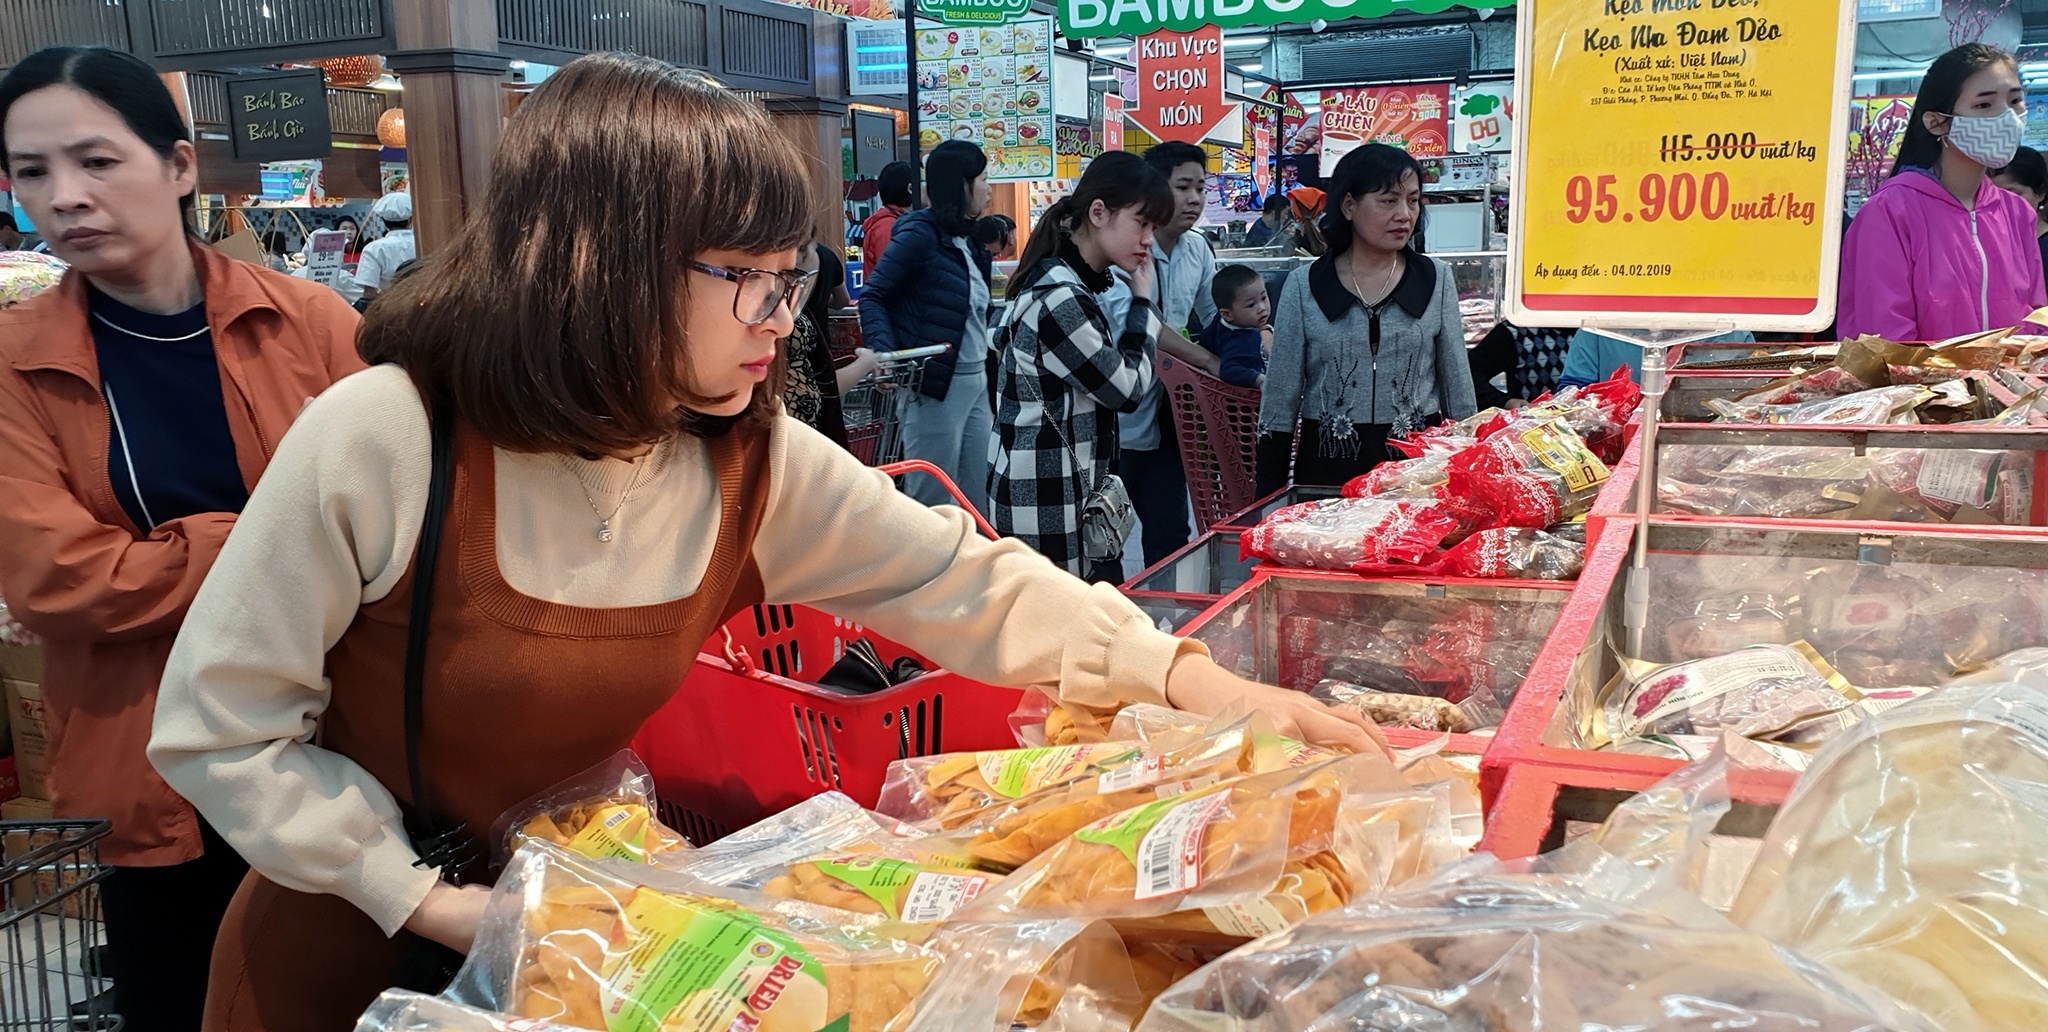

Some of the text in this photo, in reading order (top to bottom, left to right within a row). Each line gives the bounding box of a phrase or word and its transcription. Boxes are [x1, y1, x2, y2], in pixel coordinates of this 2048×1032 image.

[945, 11, 964, 19] FRESH
[971, 12, 1002, 20] DELICIOUS
[1142, 36, 1218, 60] Khu Vực
[1584, 28, 1622, 57] Kẹo
[1677, 21, 1730, 46] Đam
[1736, 17, 1782, 42] Dẻo
[1614, 48, 1747, 74] (Xuất xứ: Việt Nam)
[1152, 67, 1207, 94] CHỌN
[243, 89, 305, 113] Bánh Bao
[1159, 100, 1202, 127] MÓN
[247, 119, 305, 141] Bánh Giò
[1324, 112, 1374, 130] CHIÊN
[1409, 145, 1424, 154] 05
[1660, 131, 1816, 163] 115.900 vnđ/kg
[1565, 171, 1816, 227] 95.900 vnđ/kg
[1534, 262, 1549, 280] Áp
[1552, 263, 1578, 280] dụng
[1581, 262, 1600, 277] đến
[1611, 264, 1672, 277] 04.02.2019
[747, 953, 804, 1013] DRIED
